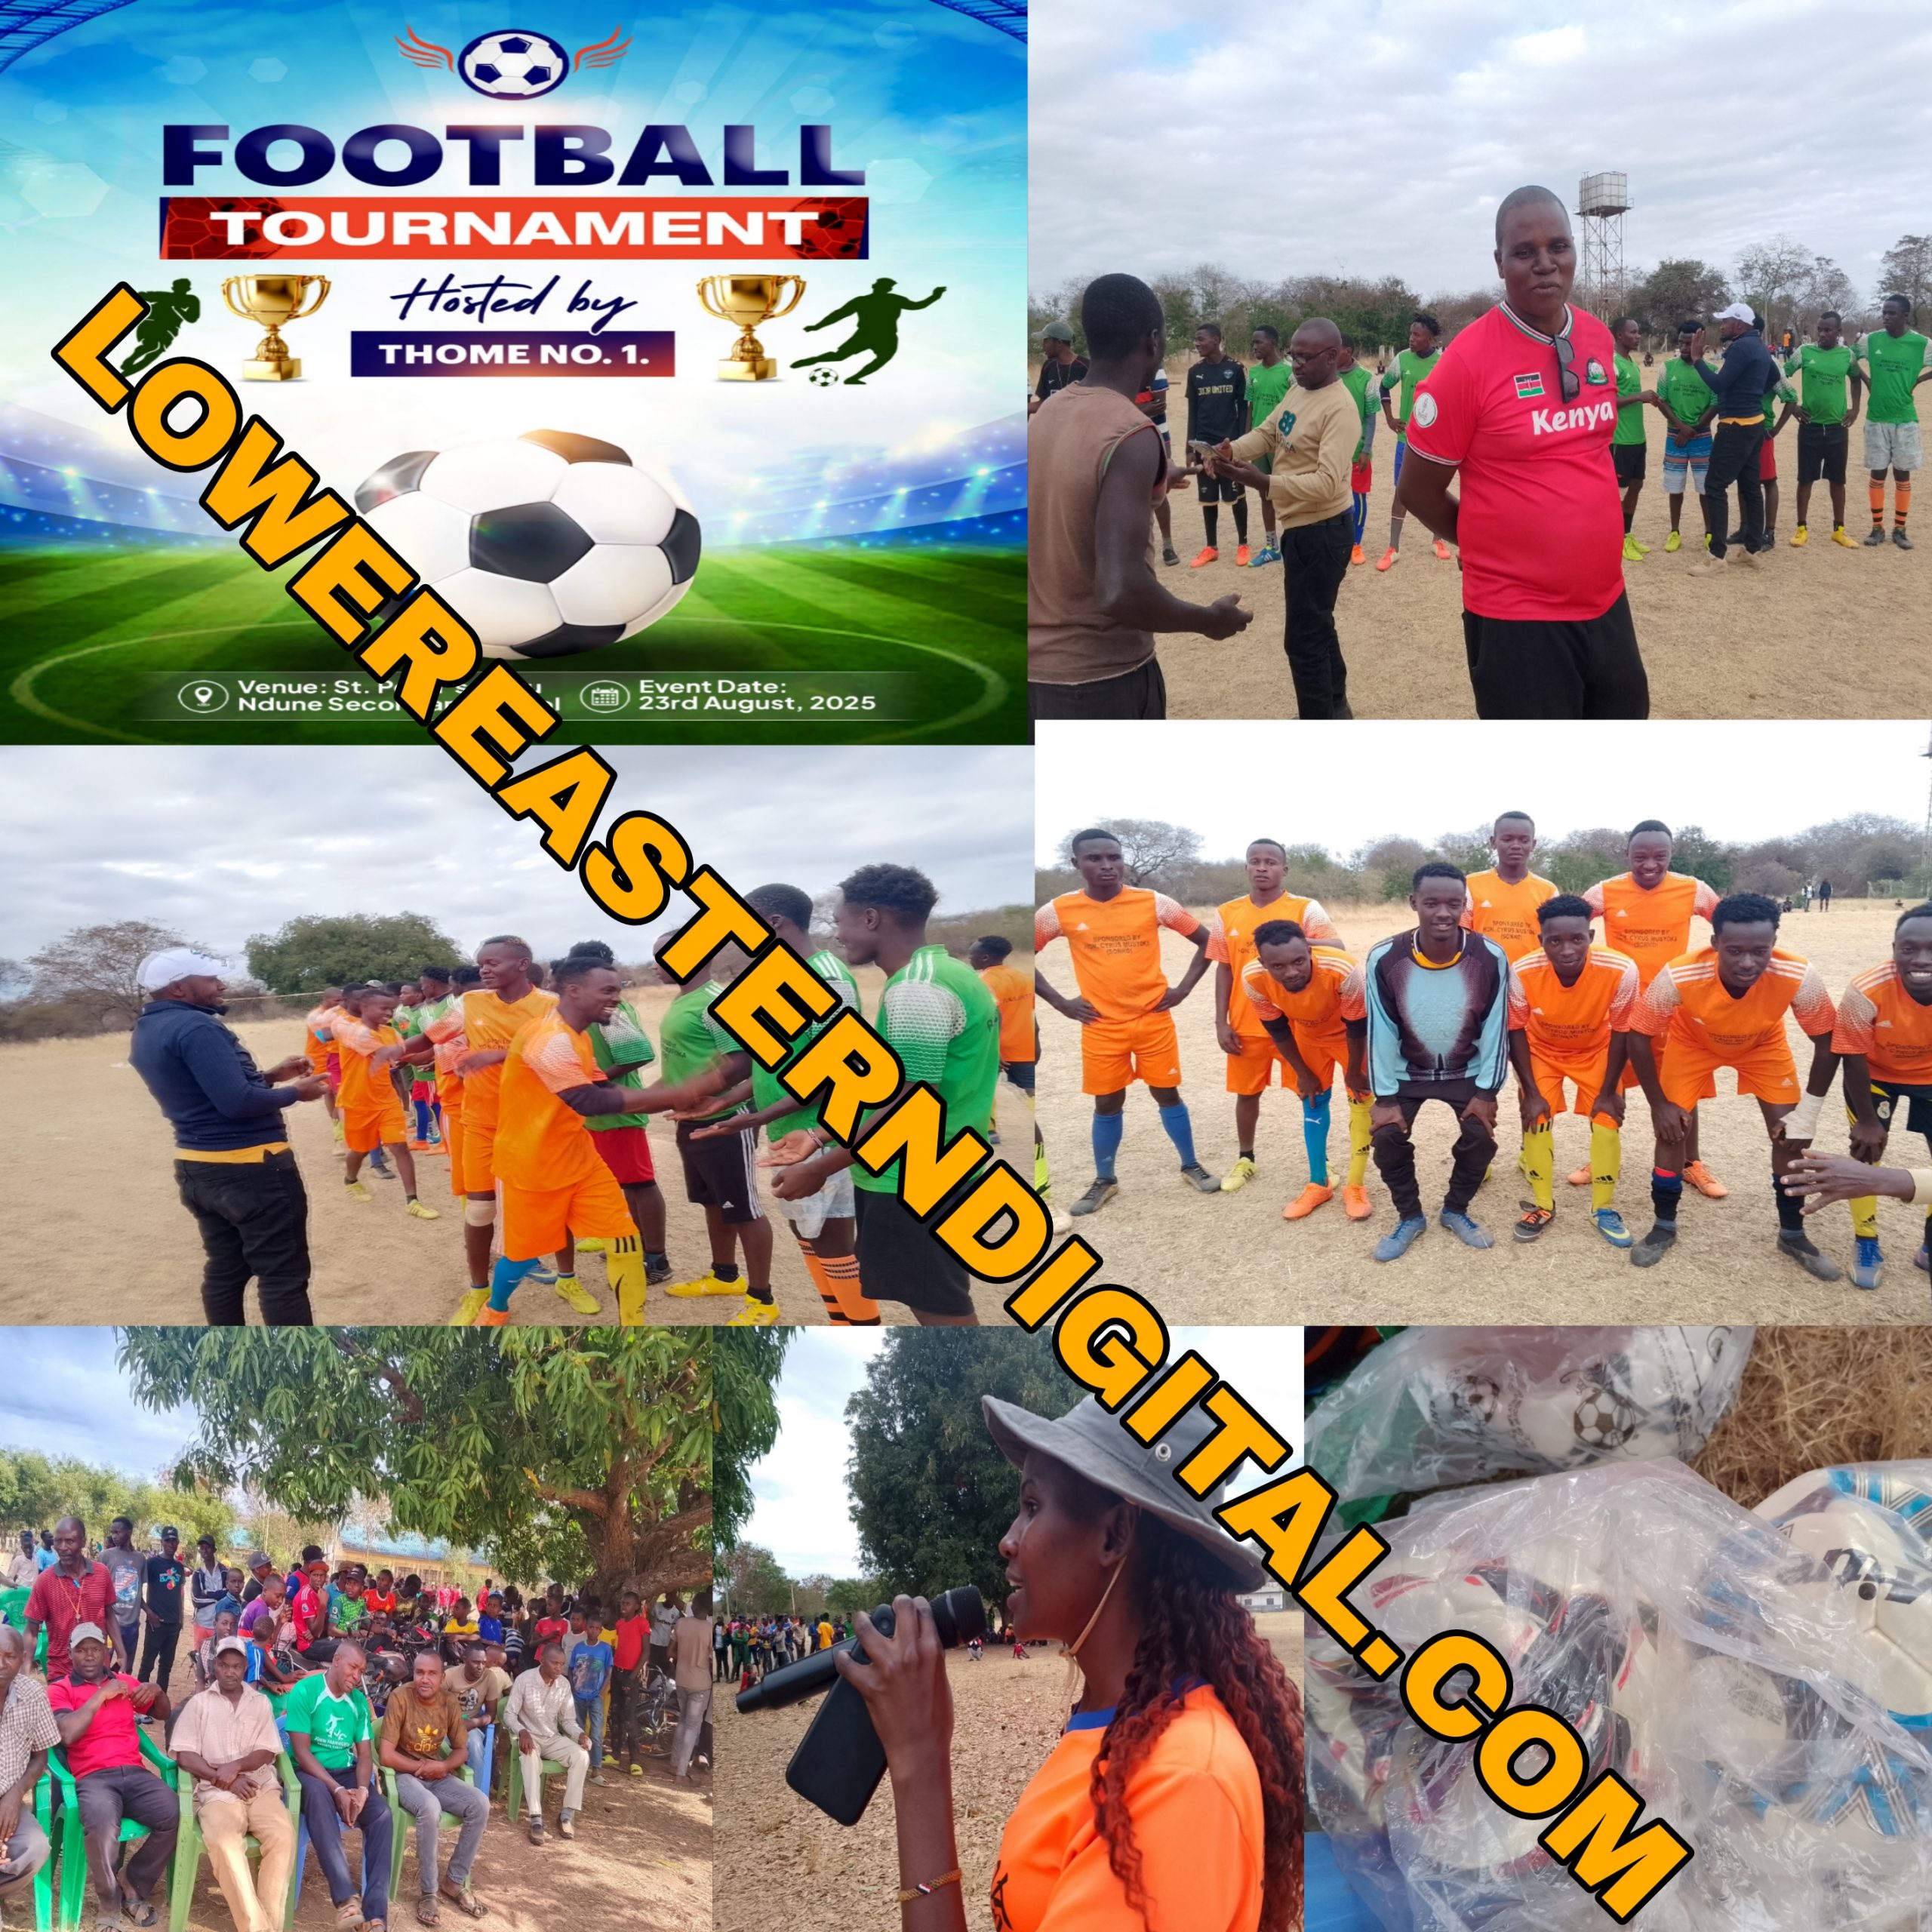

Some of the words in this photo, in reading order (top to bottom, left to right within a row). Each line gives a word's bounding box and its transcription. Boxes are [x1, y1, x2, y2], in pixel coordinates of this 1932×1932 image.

[162, 123, 866, 187] FOOTBALL
[209, 210, 820, 246] TOURNAMENT
[389, 273, 561, 324] Hosted
[566, 279, 639, 334] by
[378, 344, 531, 365] THOME
[540, 343, 612, 365] NO.
[621, 344, 650, 365] 1.
[1531, 401, 1614, 435] Kenya
[238, 680, 327, 694] Venue:
[334, 680, 370, 694] St.
[639, 679, 712, 694] Event
[718, 679, 786, 694] Date:
[238, 697, 323, 712] Ndune
[639, 696, 698, 710] 23rd
[703, 696, 803, 713] August,
[810, 696, 876, 710] 2025
